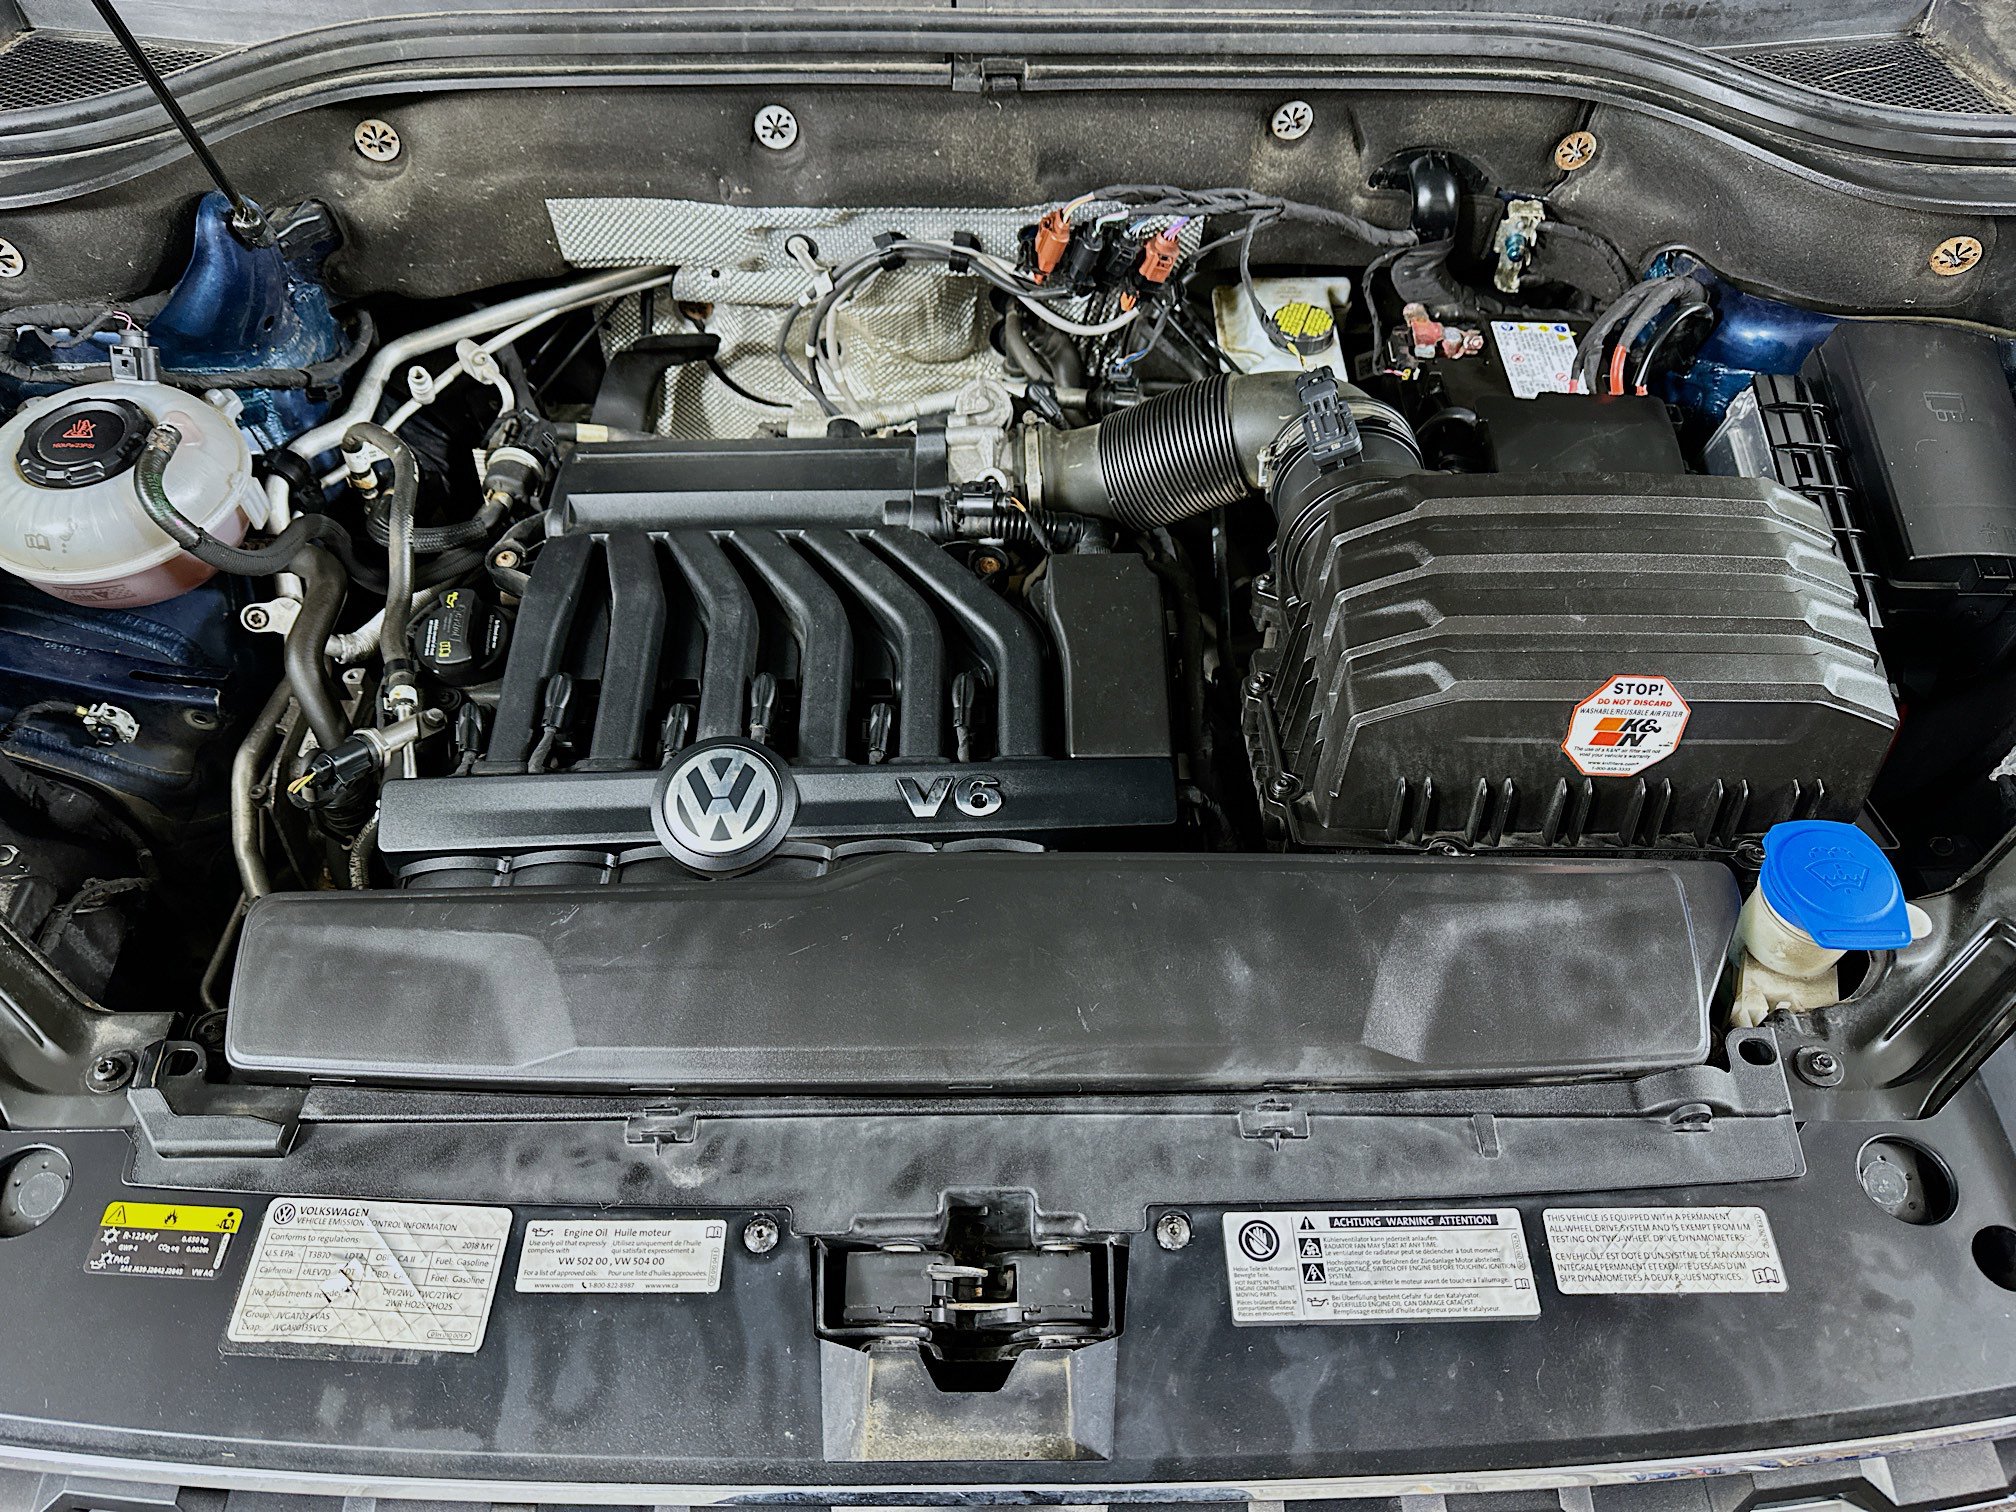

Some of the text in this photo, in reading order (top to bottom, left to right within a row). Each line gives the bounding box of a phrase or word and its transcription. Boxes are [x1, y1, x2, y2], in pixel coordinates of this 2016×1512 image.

[1614, 682, 1664, 696] STOP!
[896, 774, 1003, 819] V6
[298, 1205, 369, 1217] VOLKSWAGEN
[1332, 1215, 1492, 1226] ACHTUNG WARNING ATTENTION
[1609, 1214, 1650, 1222] EQUIPPED
[295, 1216, 458, 1230] VEHICLE EMISSION ONTROL INFORMATION
[1548, 1224, 1595, 1232] ALL-WHEEL
[122, 1231, 159, 1242] R-1234yf
[269, 1232, 306, 1241] Conforms
[307, 1234, 316, 1242] to
[563, 1228, 593, 1238] Engine
[594, 1228, 608, 1236] Oil
[614, 1228, 637, 1236] Huile
[113, 1255, 131, 1264] PAG
[1554, 1252, 1566, 1260] CE
[455, 1258, 490, 1266] Gasoline
[1599, 1262, 1647, 1270] PERMANENT
[1647, 1262, 1658, 1270] ET
[191, 1268, 203, 1276] VW
[204, 1269, 215, 1277] AG
[451, 1275, 485, 1284] Gasoline
[1559, 1274, 1576, 1282] SUR
[1650, 1273, 1673, 1281] DEUX
[264, 1288, 313, 1299] adjustments
